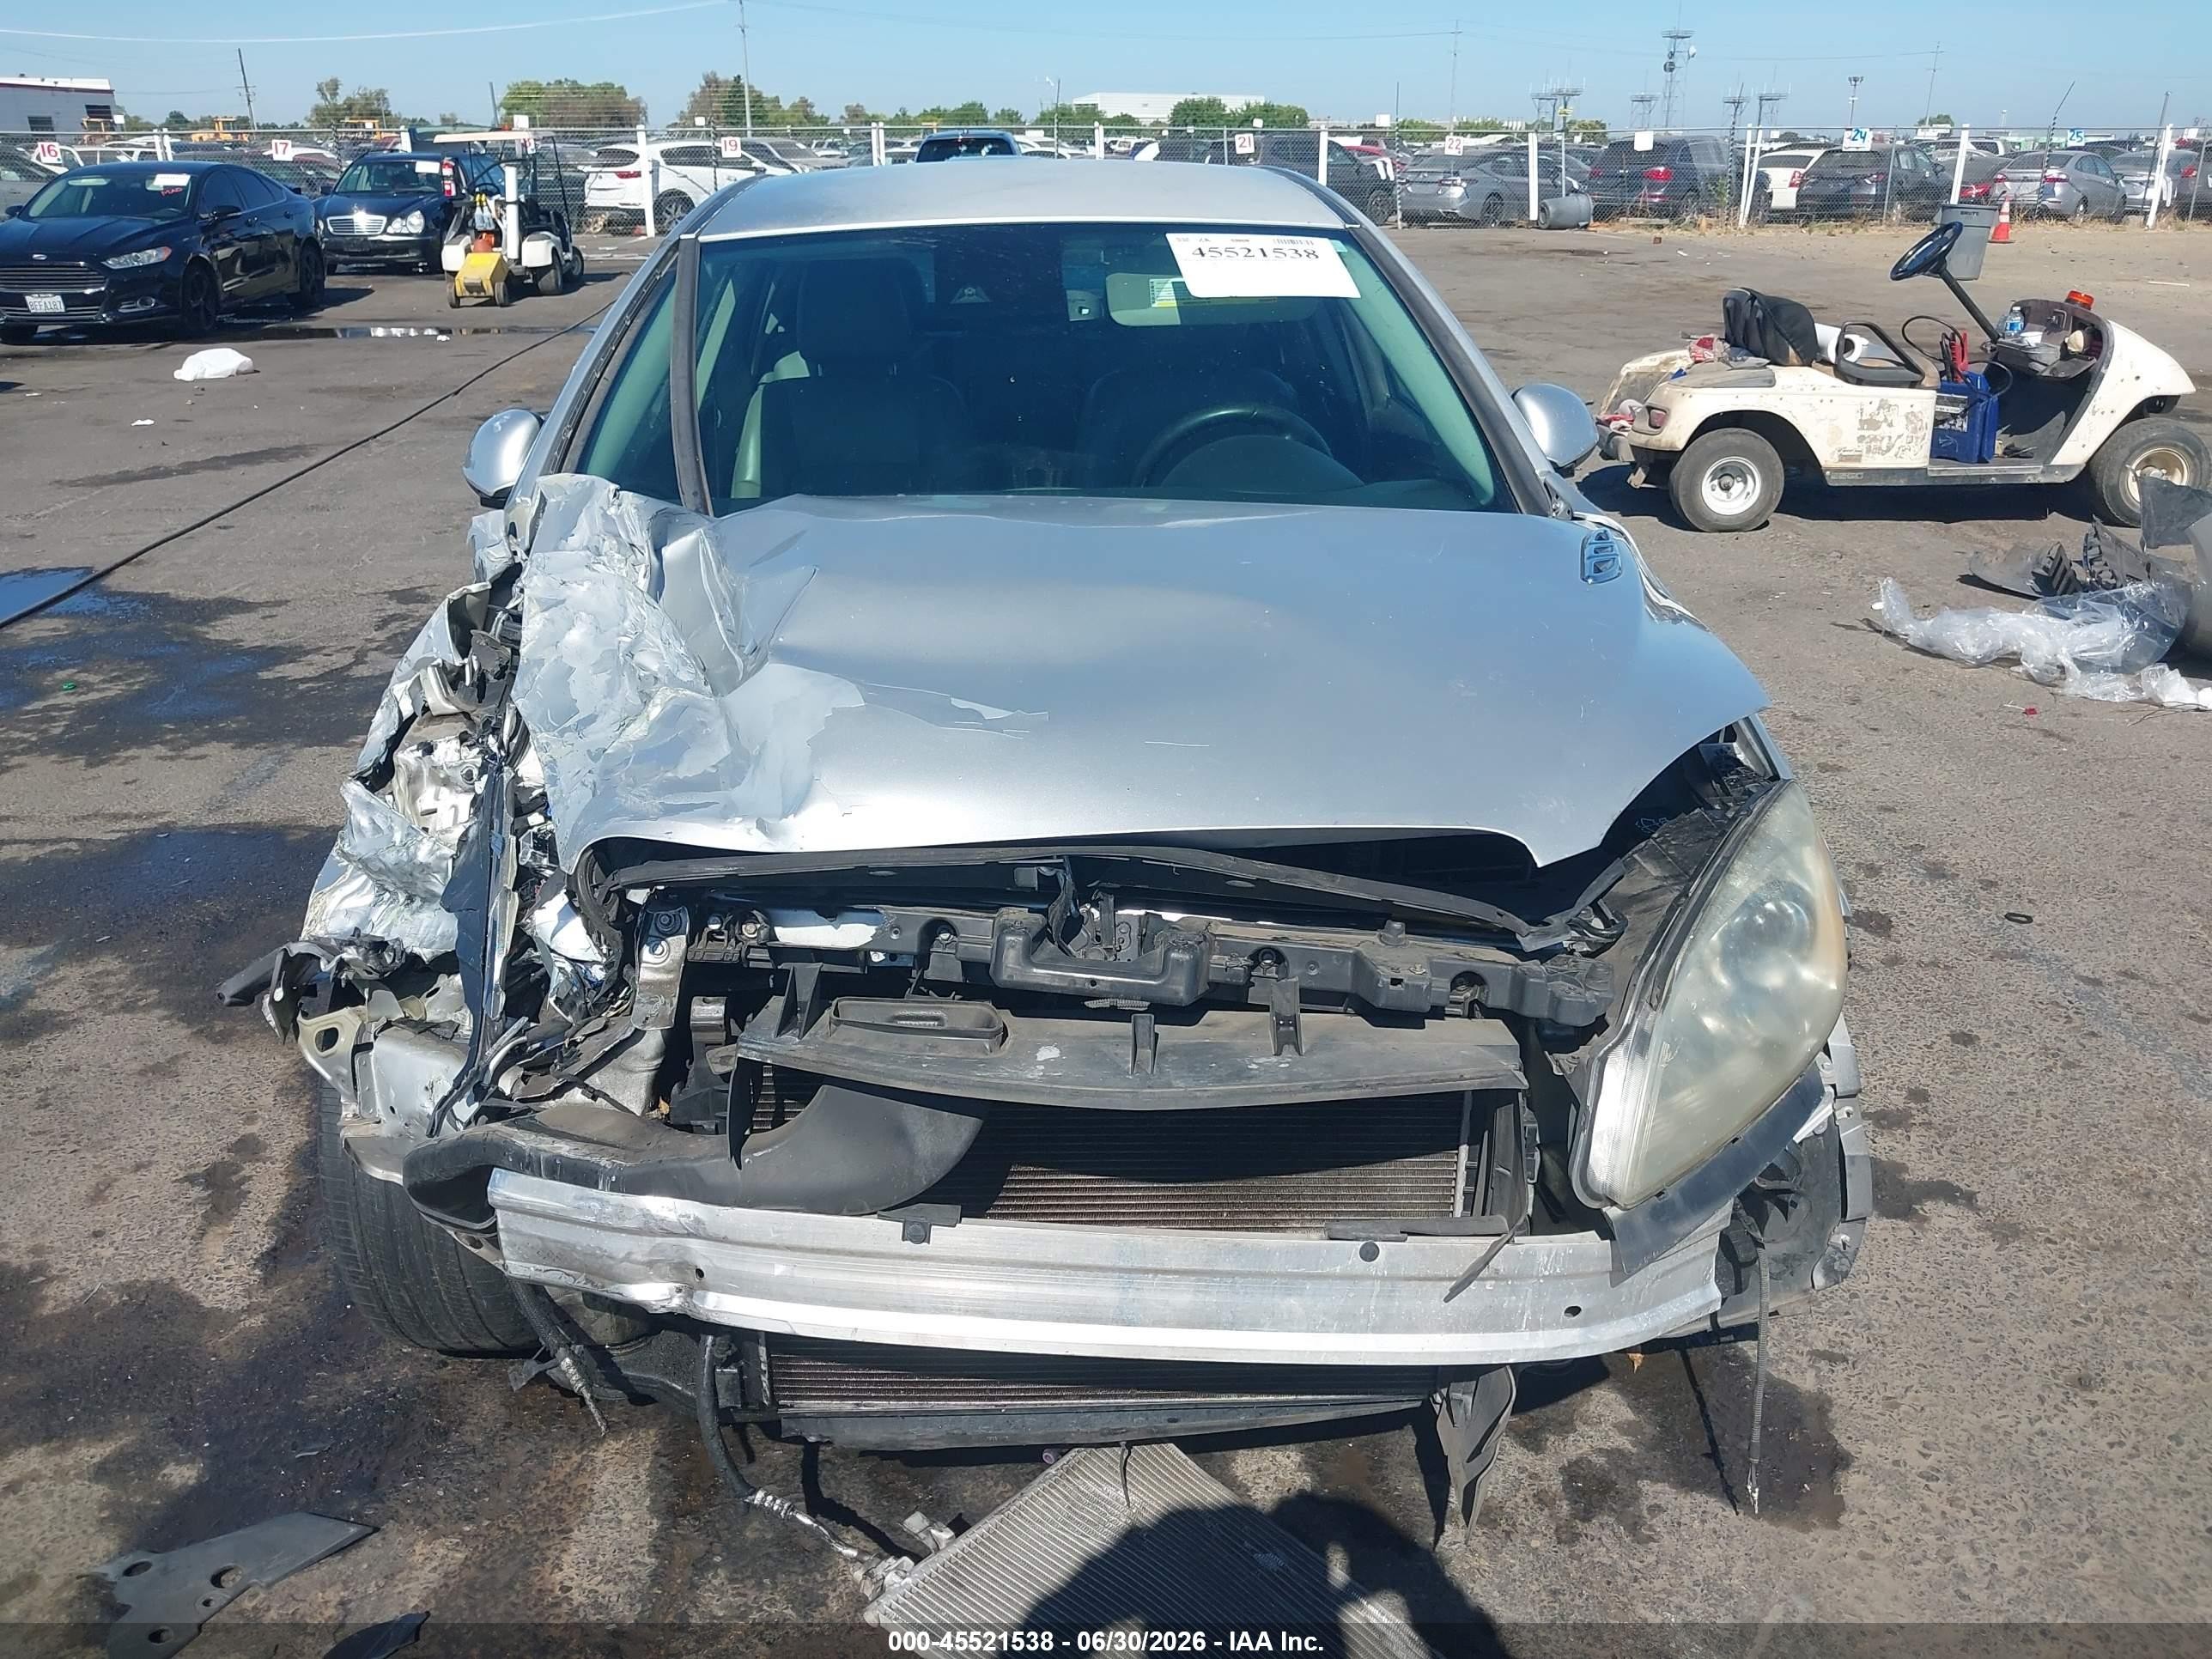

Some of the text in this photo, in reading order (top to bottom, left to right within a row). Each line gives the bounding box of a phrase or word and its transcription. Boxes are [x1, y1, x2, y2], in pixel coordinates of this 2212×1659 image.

[1237, 136, 1251, 148] 21
[1851, 129, 1868, 143] 24
[2069, 128, 2083, 143] 25
[274, 142, 289, 155] 17
[723, 139, 738, 152] 19
[1448, 137, 1462, 150] 22
[40, 143, 58, 158] 16
[1191, 246, 1320, 259] 45521538
